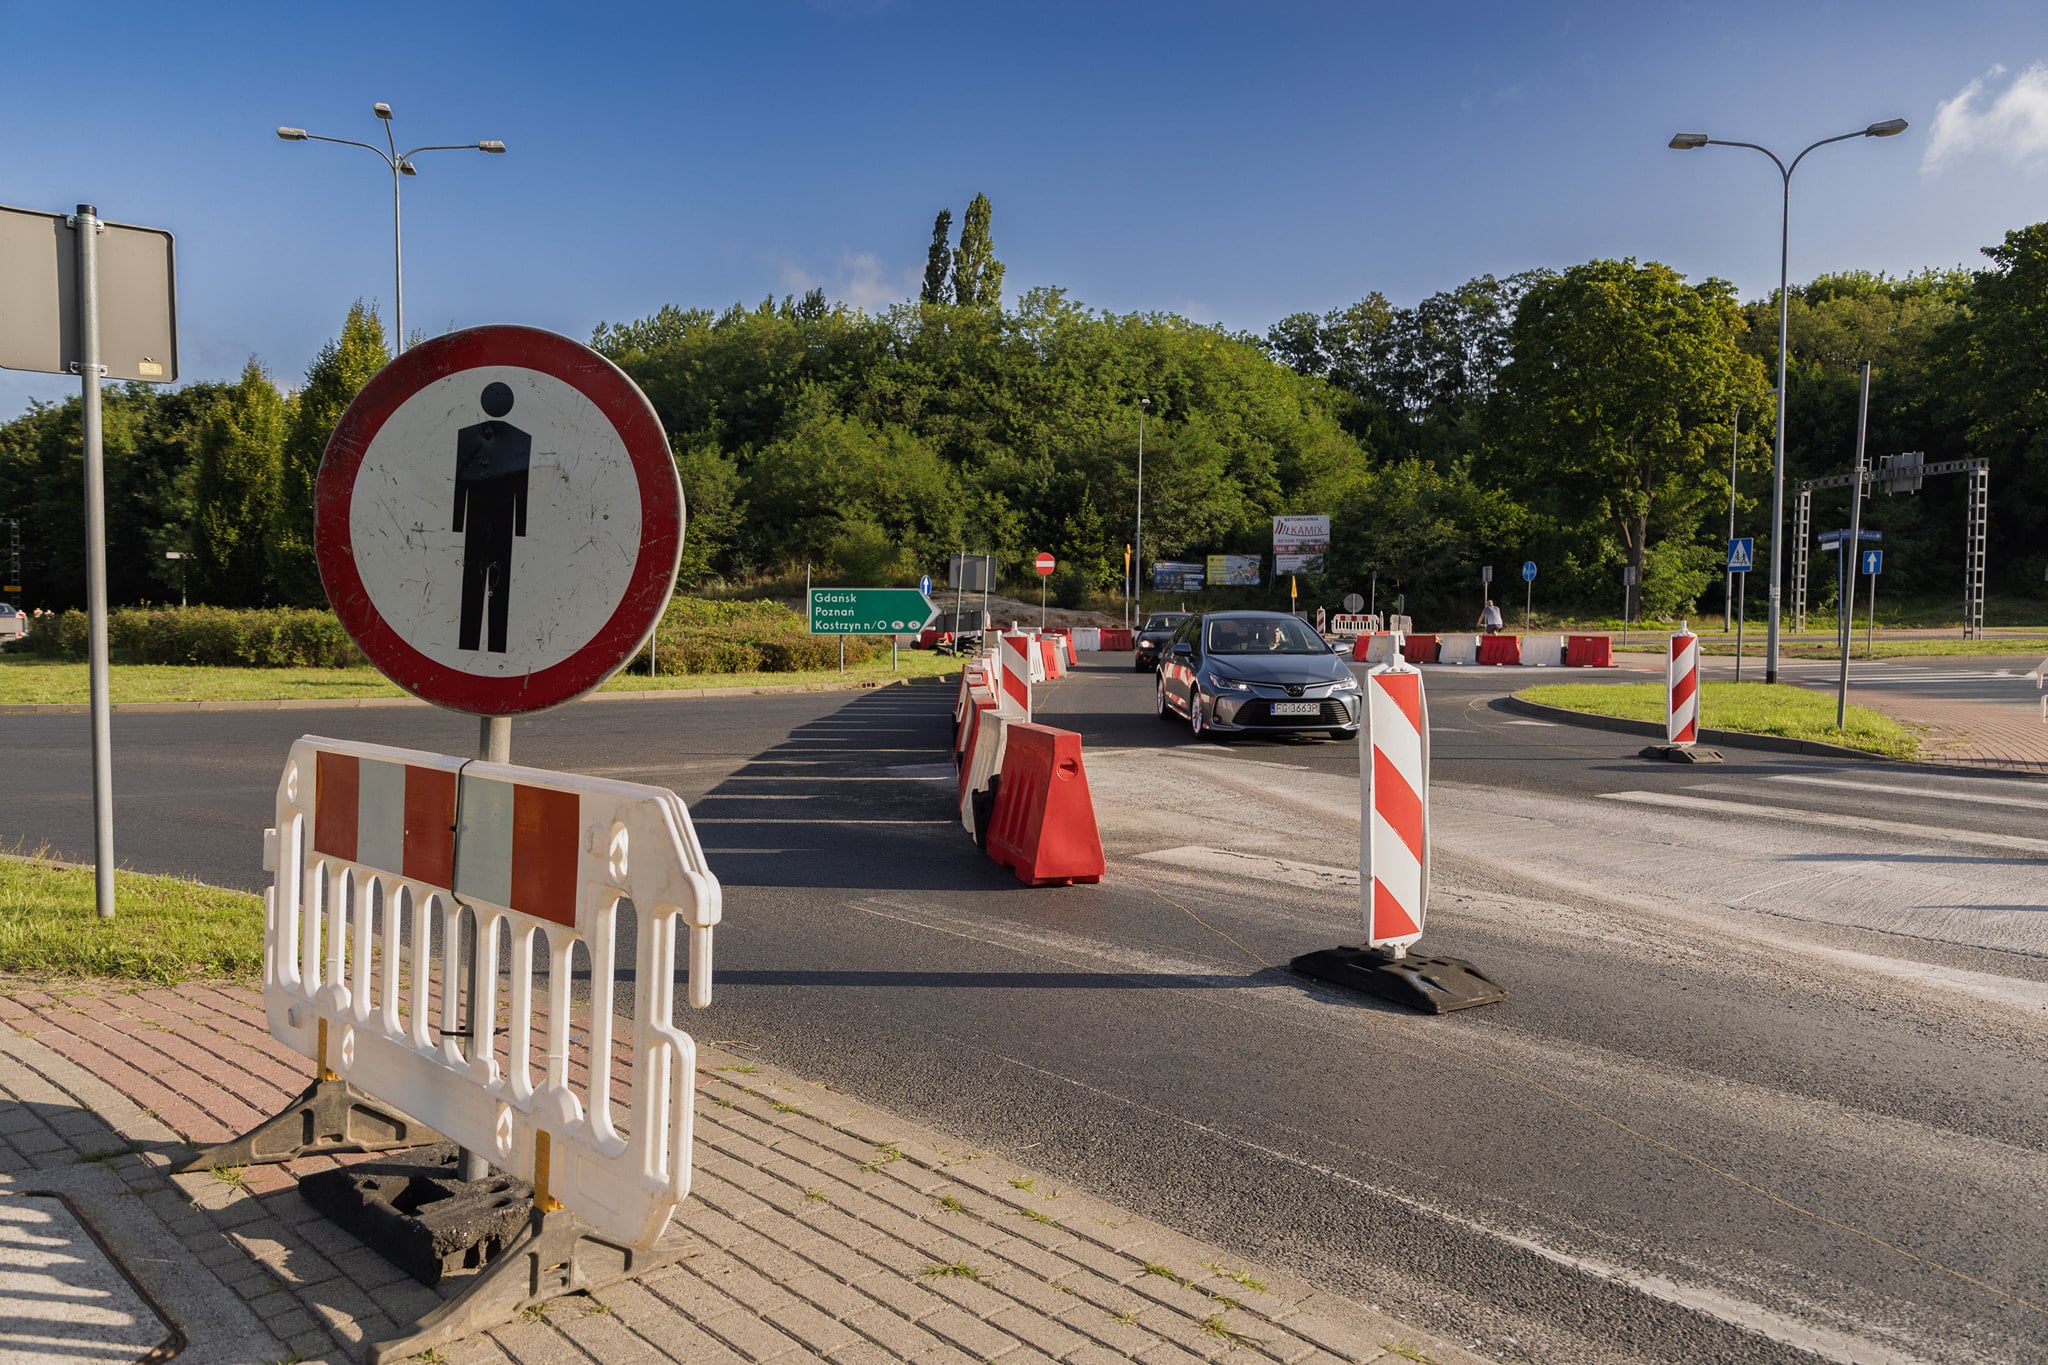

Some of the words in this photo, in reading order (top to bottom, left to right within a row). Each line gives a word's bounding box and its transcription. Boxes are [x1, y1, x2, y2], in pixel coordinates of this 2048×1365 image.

[1291, 525, 1323, 534] KAMIX
[814, 593, 857, 603] Gdańsk
[815, 607, 855, 616] Poznań
[815, 620, 861, 632] Kostrzyn
[864, 620, 887, 630] n/O
[1276, 703, 1288, 713] FG
[1290, 703, 1318, 713] 3663P
